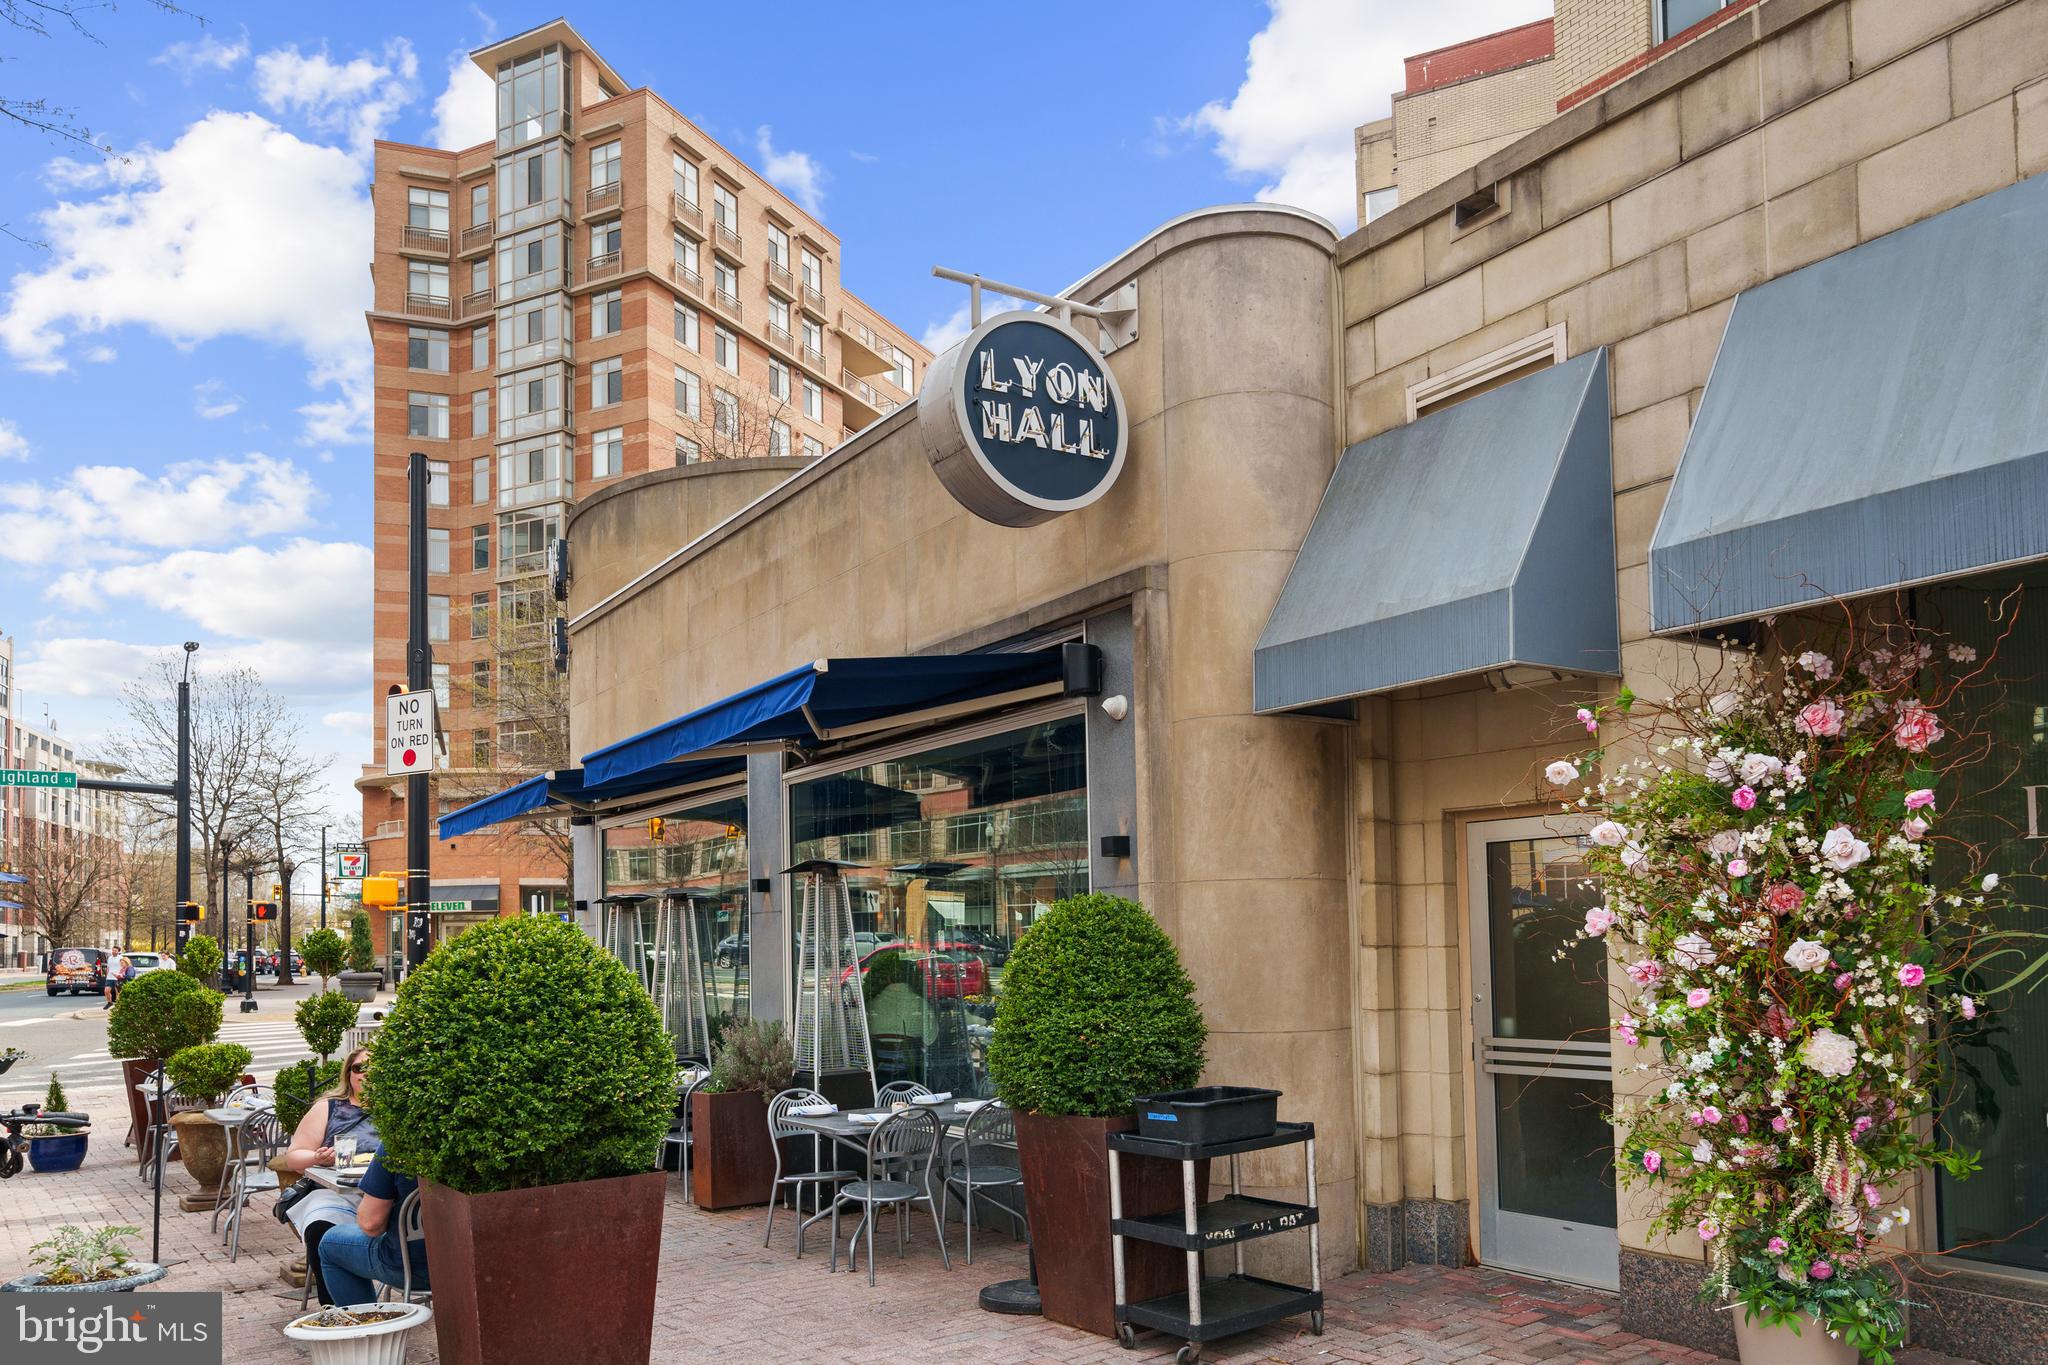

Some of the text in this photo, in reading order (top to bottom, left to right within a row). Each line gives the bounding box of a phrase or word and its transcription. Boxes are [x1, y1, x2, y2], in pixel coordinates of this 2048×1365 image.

[980, 348, 1107, 413] LYON
[981, 400, 1110, 460] HALL
[399, 699, 420, 716] NO
[396, 718, 423, 732] TURN
[390, 733, 429, 749] ON RED
[0, 770, 72, 785] ighland St
[343, 856, 361, 876] 7
